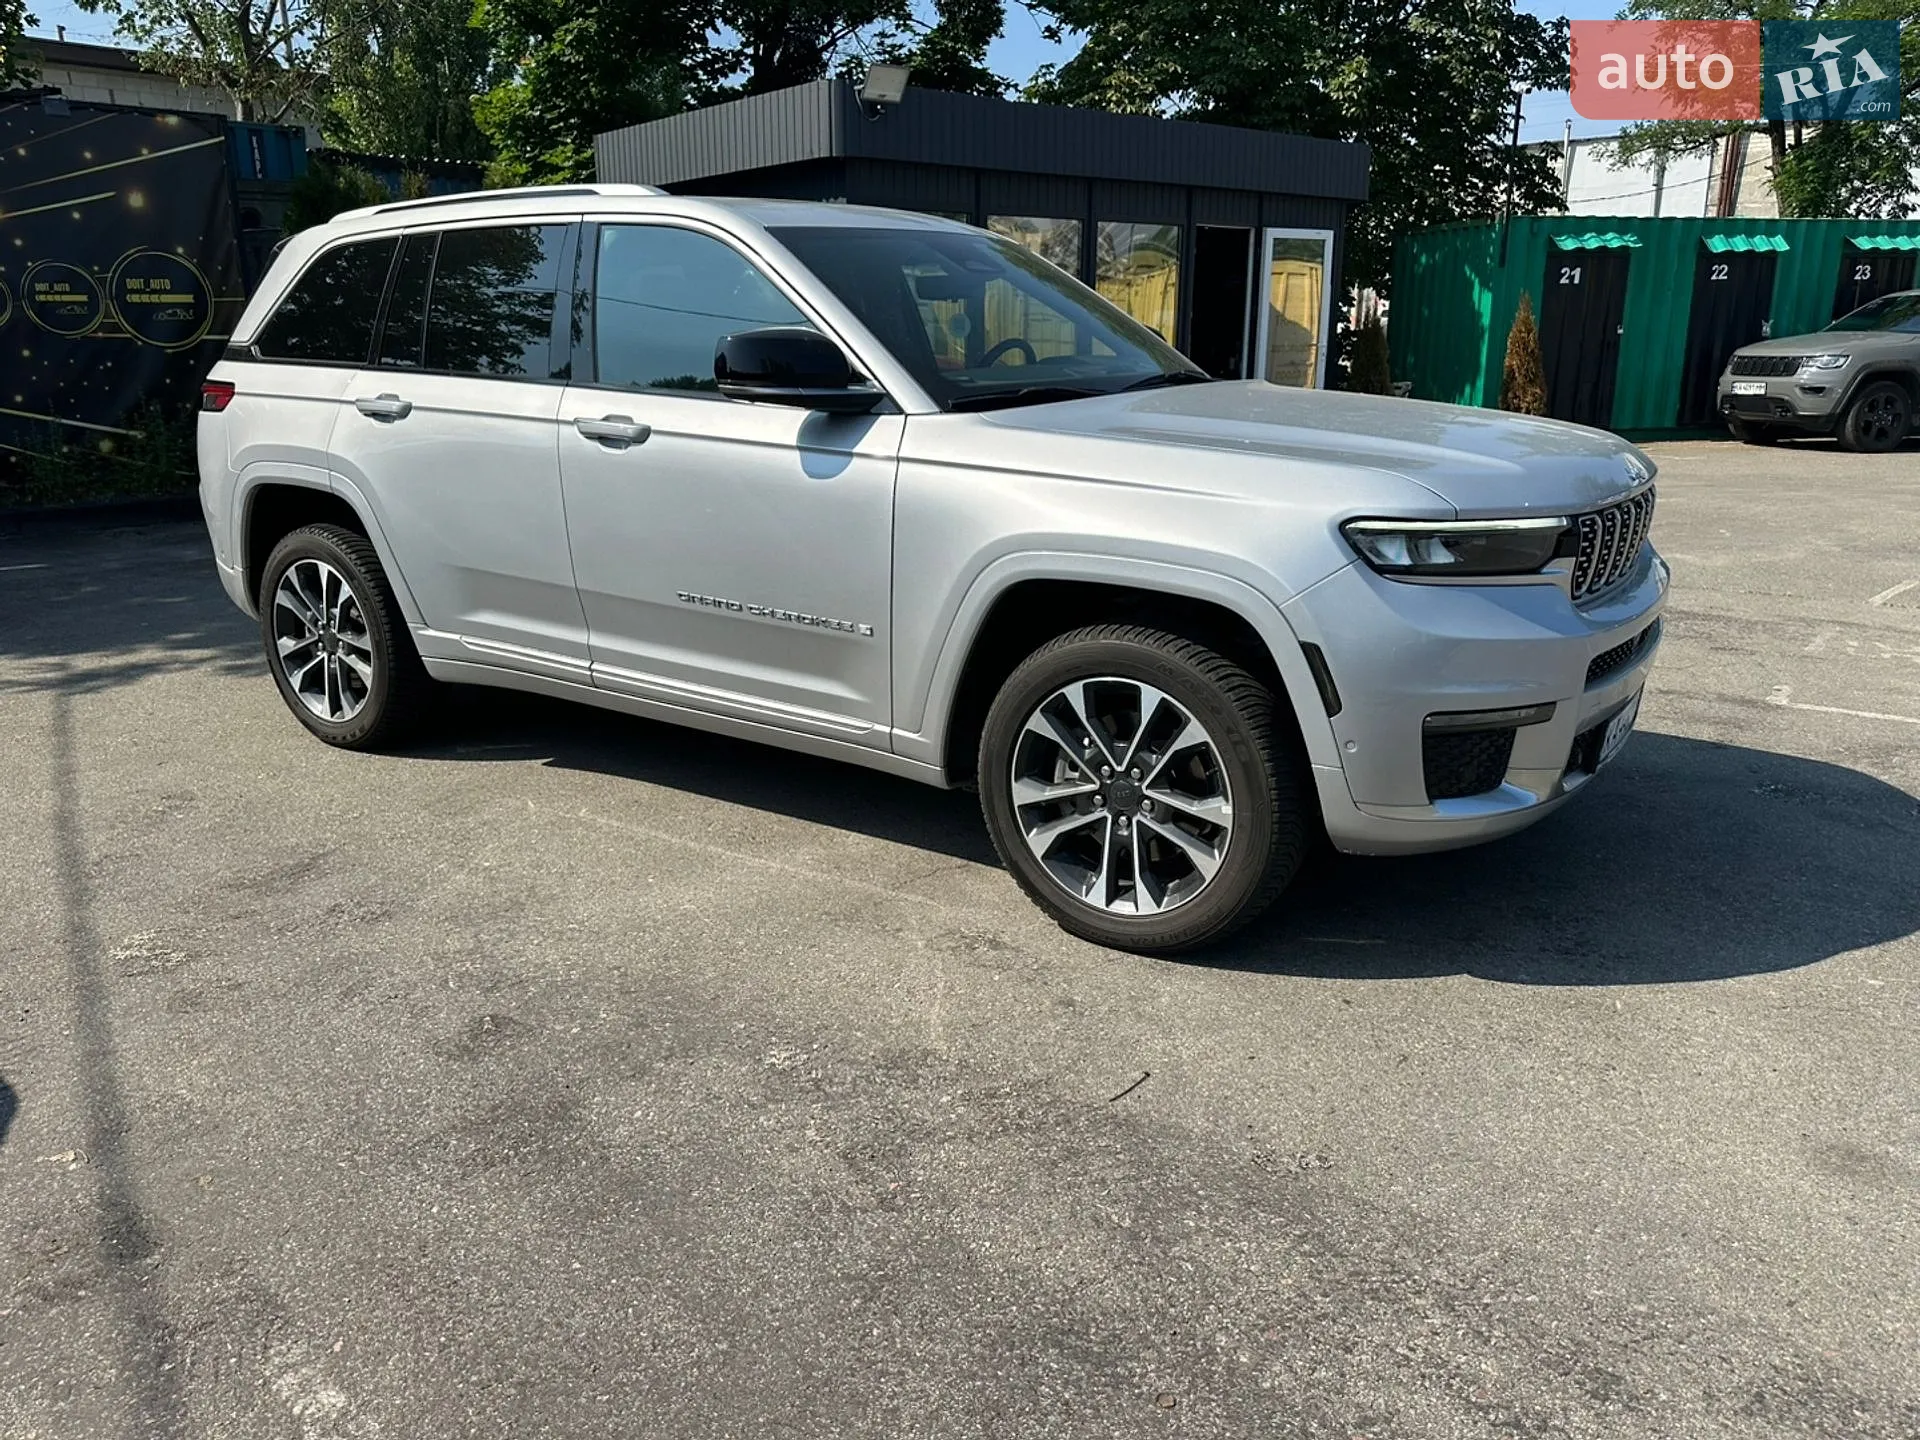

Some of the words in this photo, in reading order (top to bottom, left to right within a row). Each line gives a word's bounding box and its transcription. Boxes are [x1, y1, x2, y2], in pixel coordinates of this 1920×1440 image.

[1559, 267, 1582, 285] 21
[1710, 264, 1729, 280] 22
[1854, 265, 1871, 281] 23
[676, 590, 743, 612] GRAND
[747, 603, 855, 633] CHEROKEE
